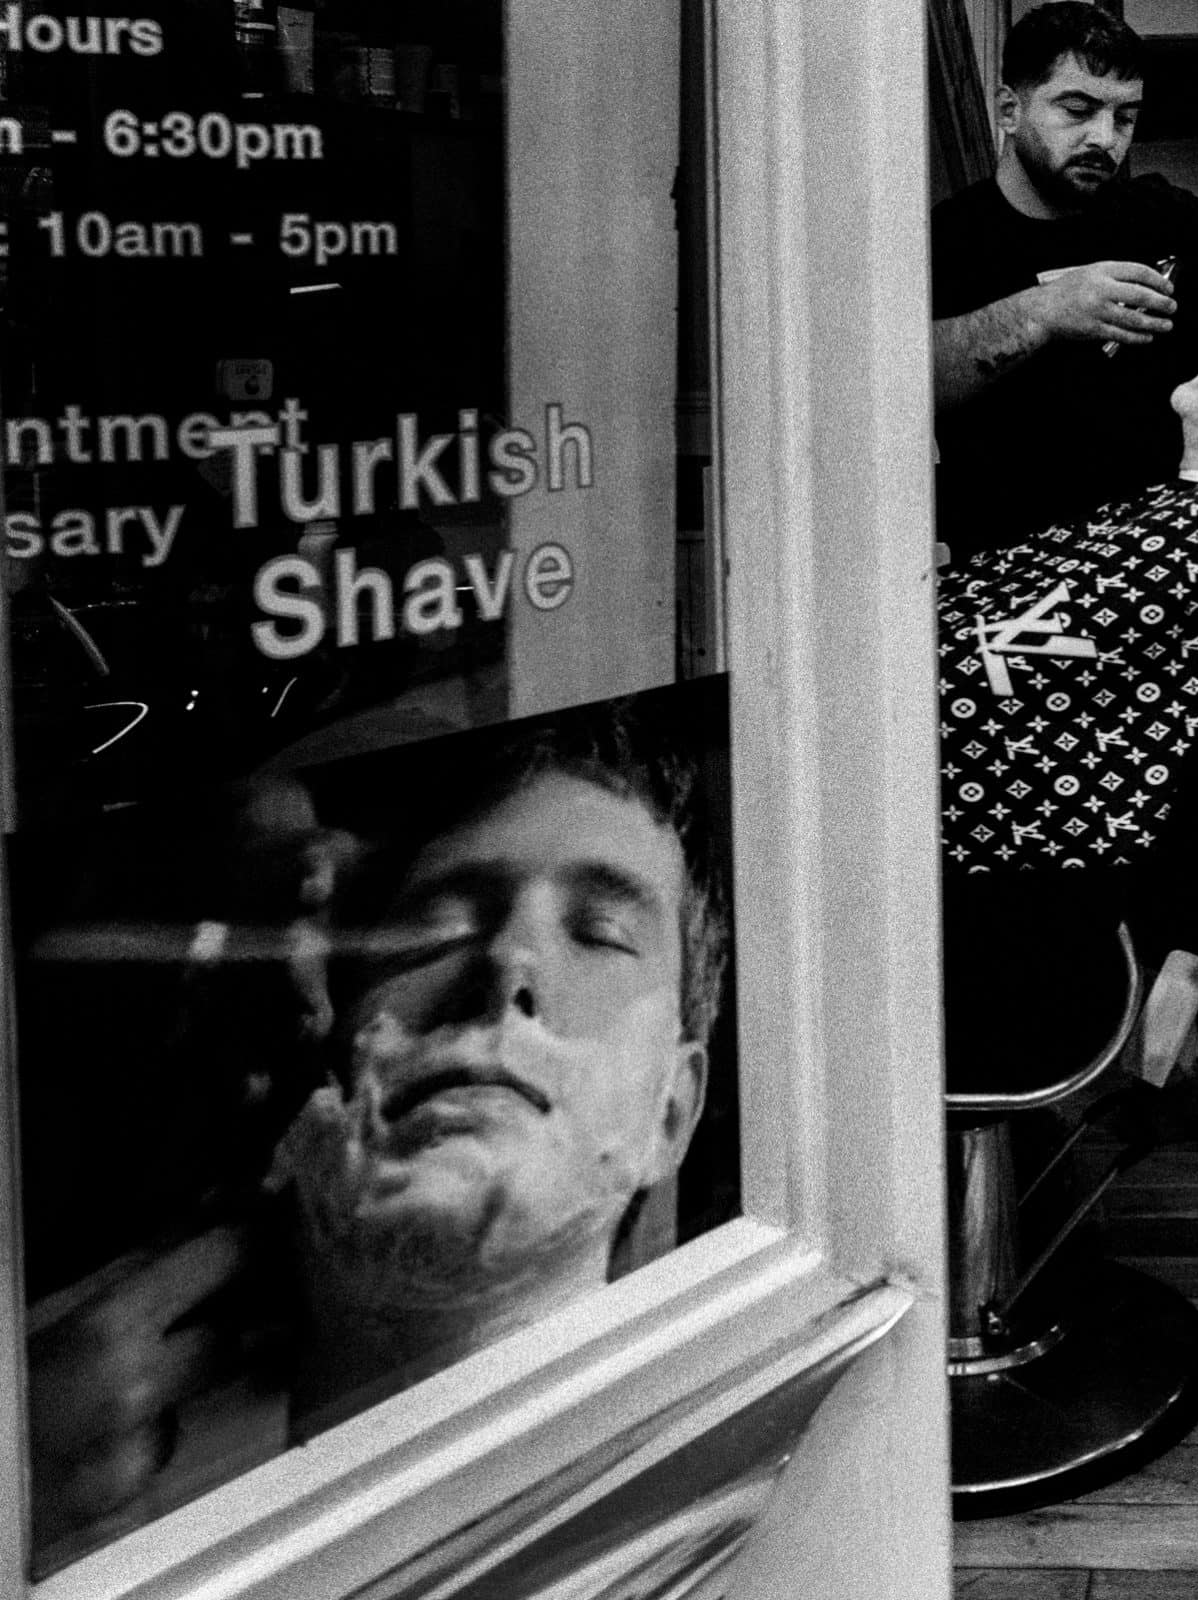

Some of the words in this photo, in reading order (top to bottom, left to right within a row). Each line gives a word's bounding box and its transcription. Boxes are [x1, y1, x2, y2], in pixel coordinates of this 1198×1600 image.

[104, 109, 323, 168] 6:30pm
[38, 211, 203, 258] 10am
[279, 213, 397, 266] 5pm
[208, 404, 593, 528] Turkish
[251, 543, 574, 660] Shave
